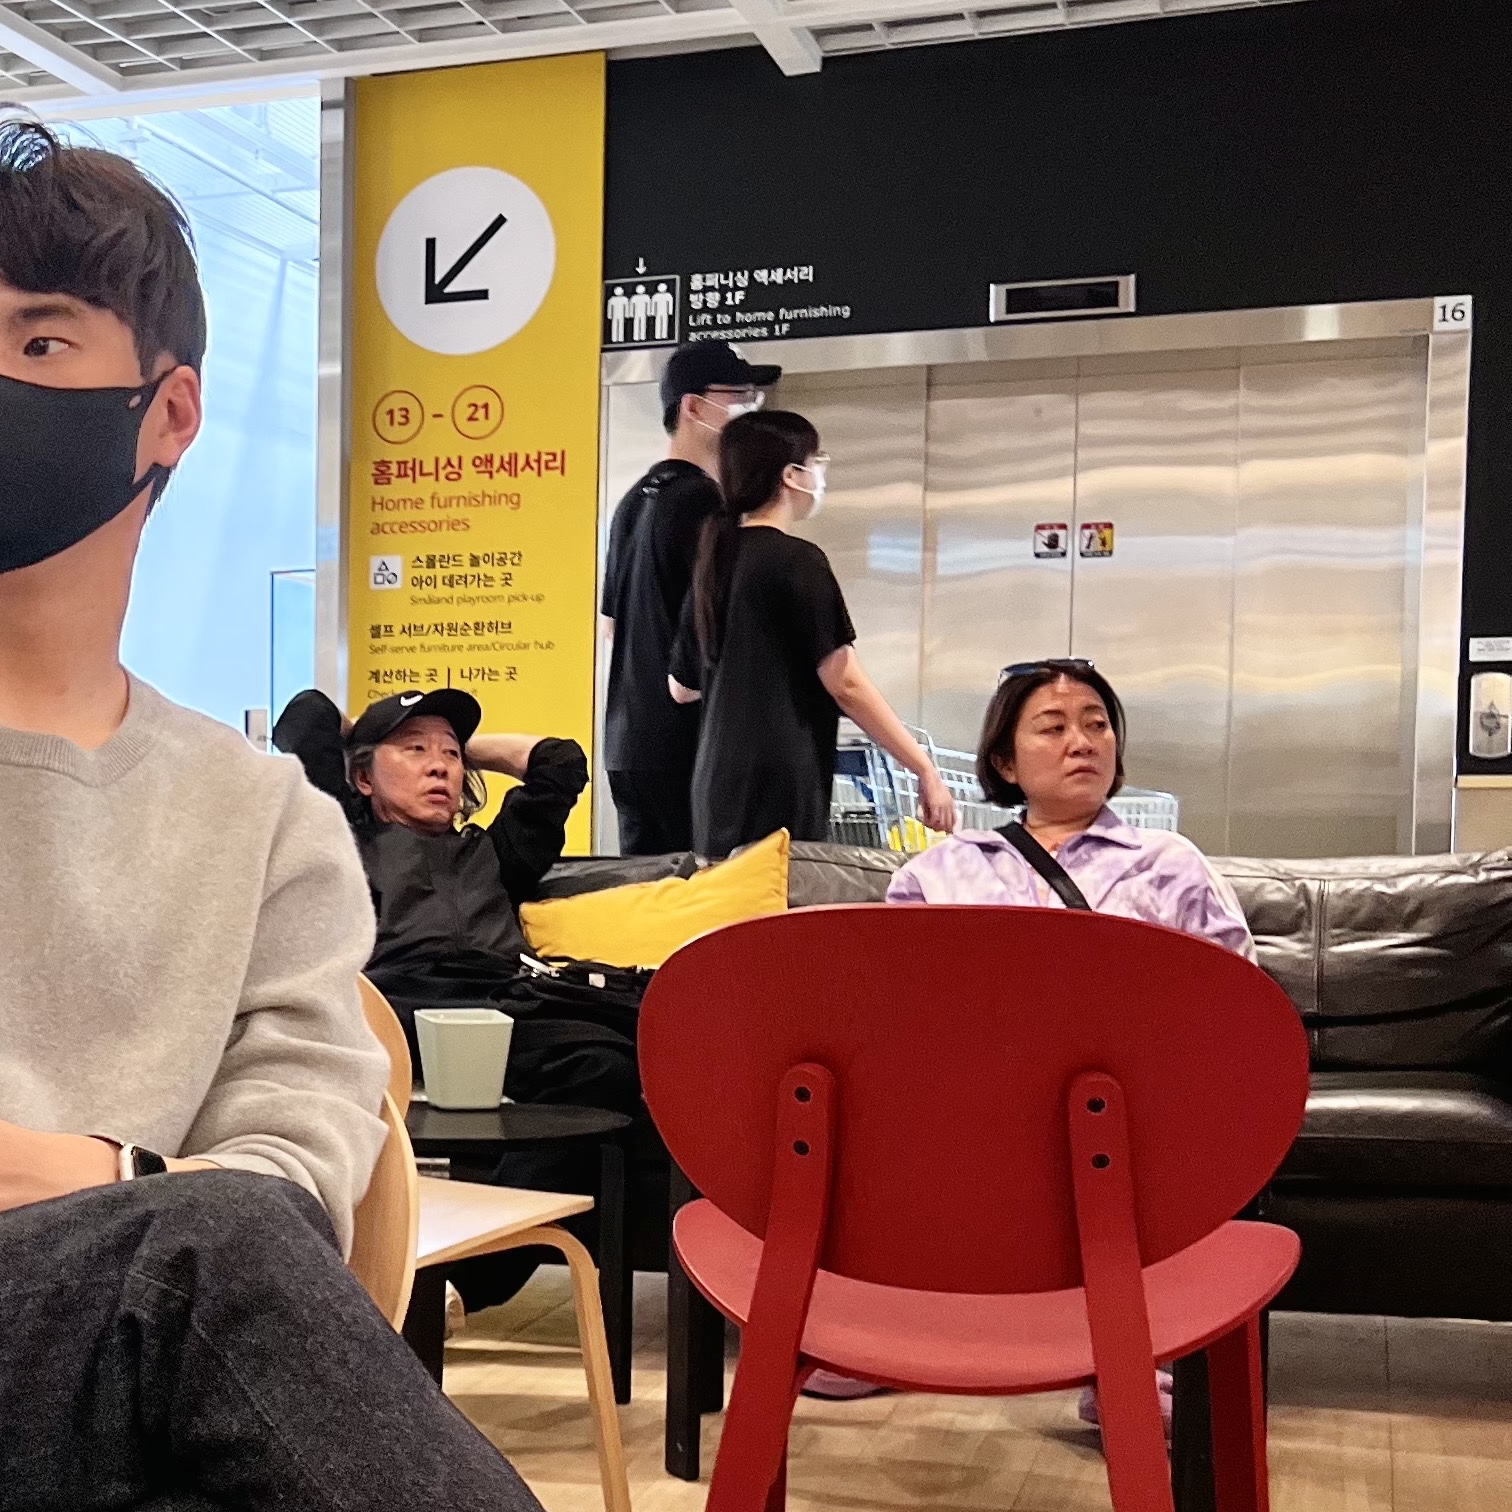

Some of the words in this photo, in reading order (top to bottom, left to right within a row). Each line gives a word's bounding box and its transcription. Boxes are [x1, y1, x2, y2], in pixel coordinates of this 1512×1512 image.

[724, 290, 746, 306] 1F
[689, 313, 712, 327] Lift
[716, 313, 731, 325] to
[736, 310, 775, 324] home
[779, 305, 851, 320] furnishing
[1438, 302, 1465, 323] 16
[688, 326, 768, 343] accessories
[774, 322, 791, 337] 1F
[385, 407, 410, 427] 13
[466, 402, 489, 422] 21
[371, 455, 463, 486] 홈퍼니싱
[472, 450, 566, 480] 액세서리
[371, 494, 425, 513] Home
[430, 489, 521, 511] furnishing
[370, 514, 471, 535] accessories
[411, 553, 464, 570] 스몰란드
[469, 550, 523, 567] 놀이공간
[411, 574, 437, 590] 아이
[441, 573, 495, 589] 데려가는
[500, 572, 513, 587] 곳
[369, 624, 395, 639] 셀프
[399, 620, 513, 638] 서브/자원순환허브
[367, 668, 421, 684] 계산하는
[424, 667, 438, 683] 곳
[460, 666, 500, 682] 나가는
[505, 666, 518, 681] 곳
